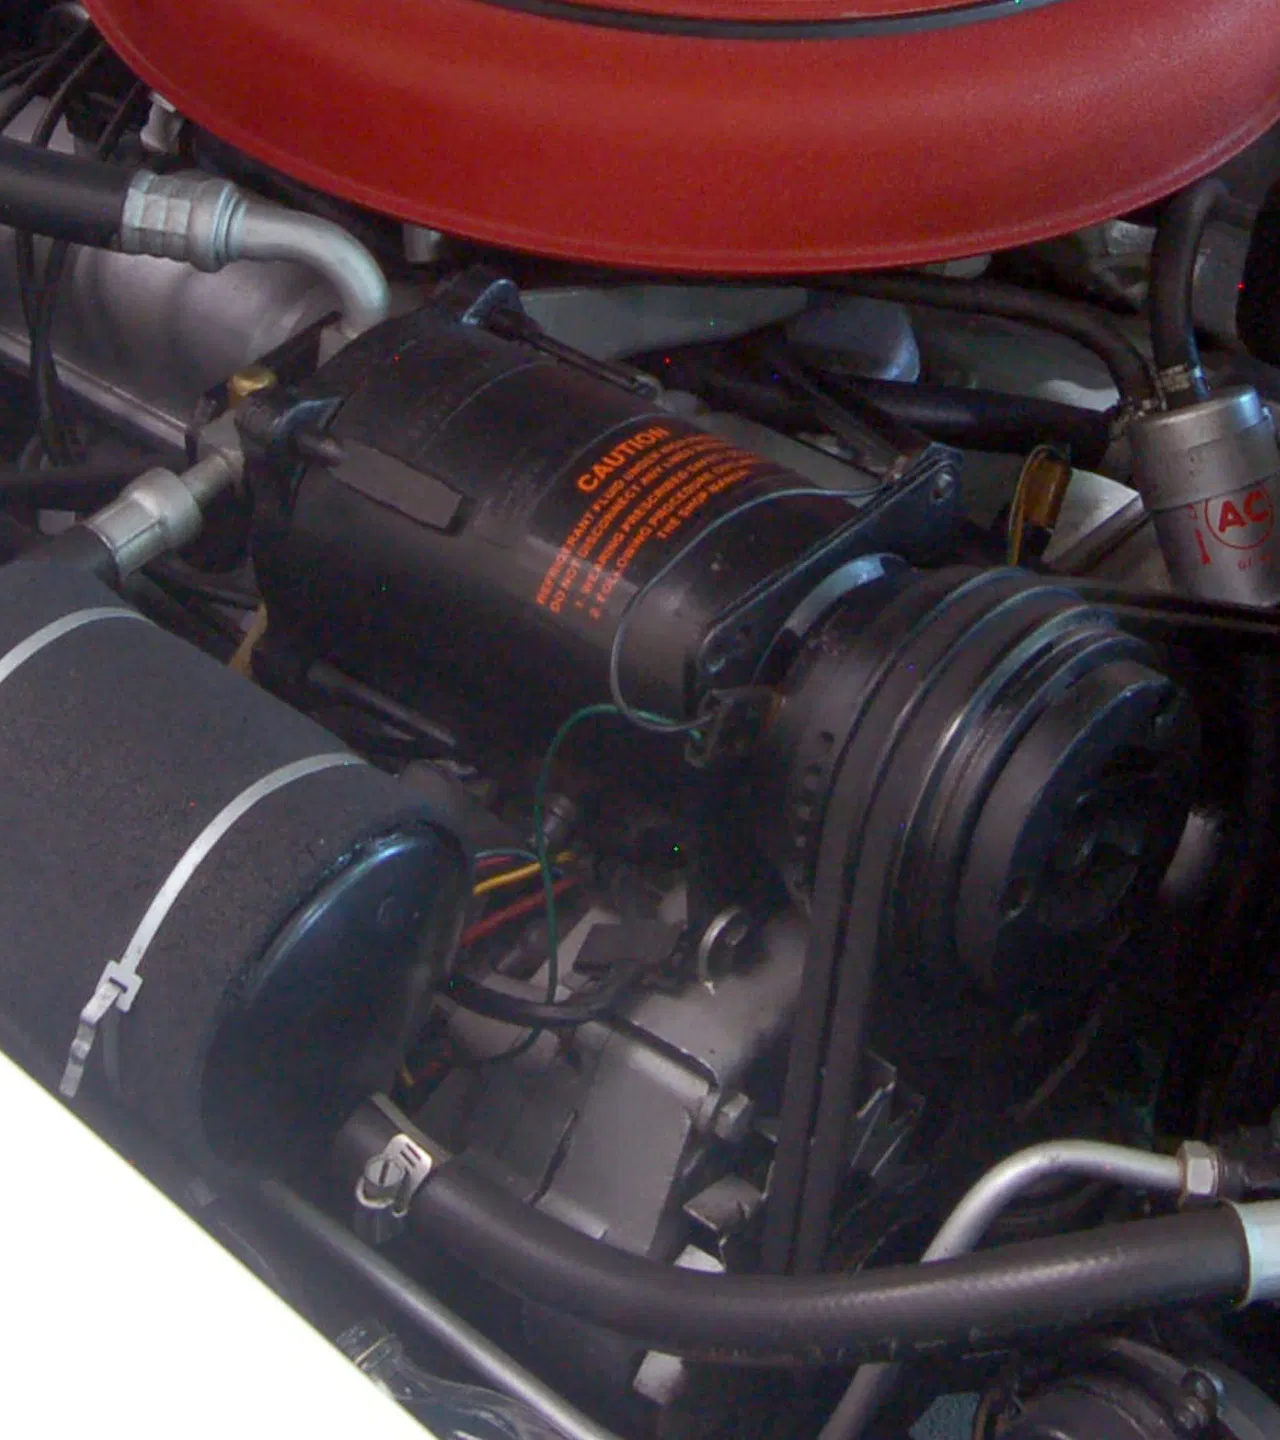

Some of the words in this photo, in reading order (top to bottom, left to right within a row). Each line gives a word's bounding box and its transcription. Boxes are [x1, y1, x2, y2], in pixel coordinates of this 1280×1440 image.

[577, 426, 672, 494] CAUTION
[591, 479, 625, 513] FLUID
[1218, 490, 1271, 533] AC
[550, 588, 567, 614] DO
[561, 557, 581, 591] NOT
[578, 483, 641, 559] DISCONNECT
